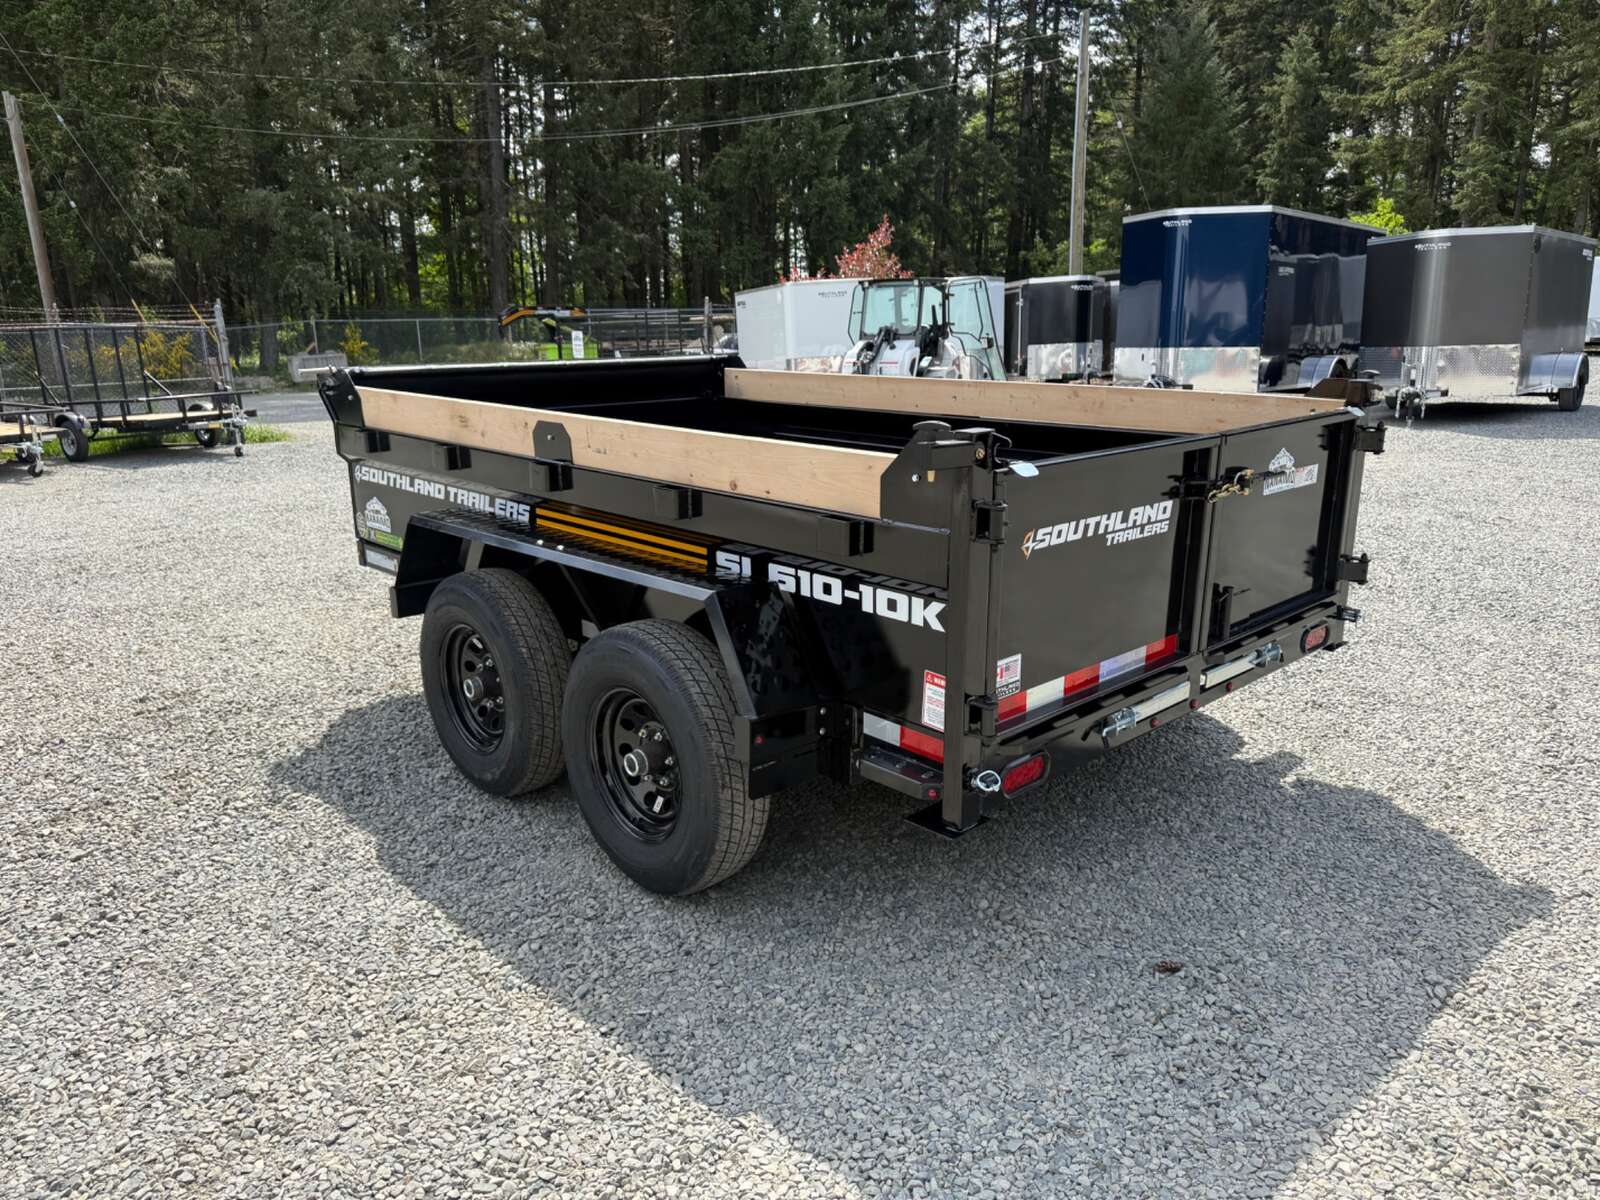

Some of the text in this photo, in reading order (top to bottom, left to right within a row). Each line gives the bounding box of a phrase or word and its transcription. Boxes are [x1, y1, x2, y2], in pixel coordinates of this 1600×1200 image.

[361, 466, 531, 523] SOUTHLAND TRAILERS
[1034, 500, 1174, 550] SOUTHLAND
[1106, 520, 1170, 546] TRAILERS
[768, 562, 946, 633] 610-10K
